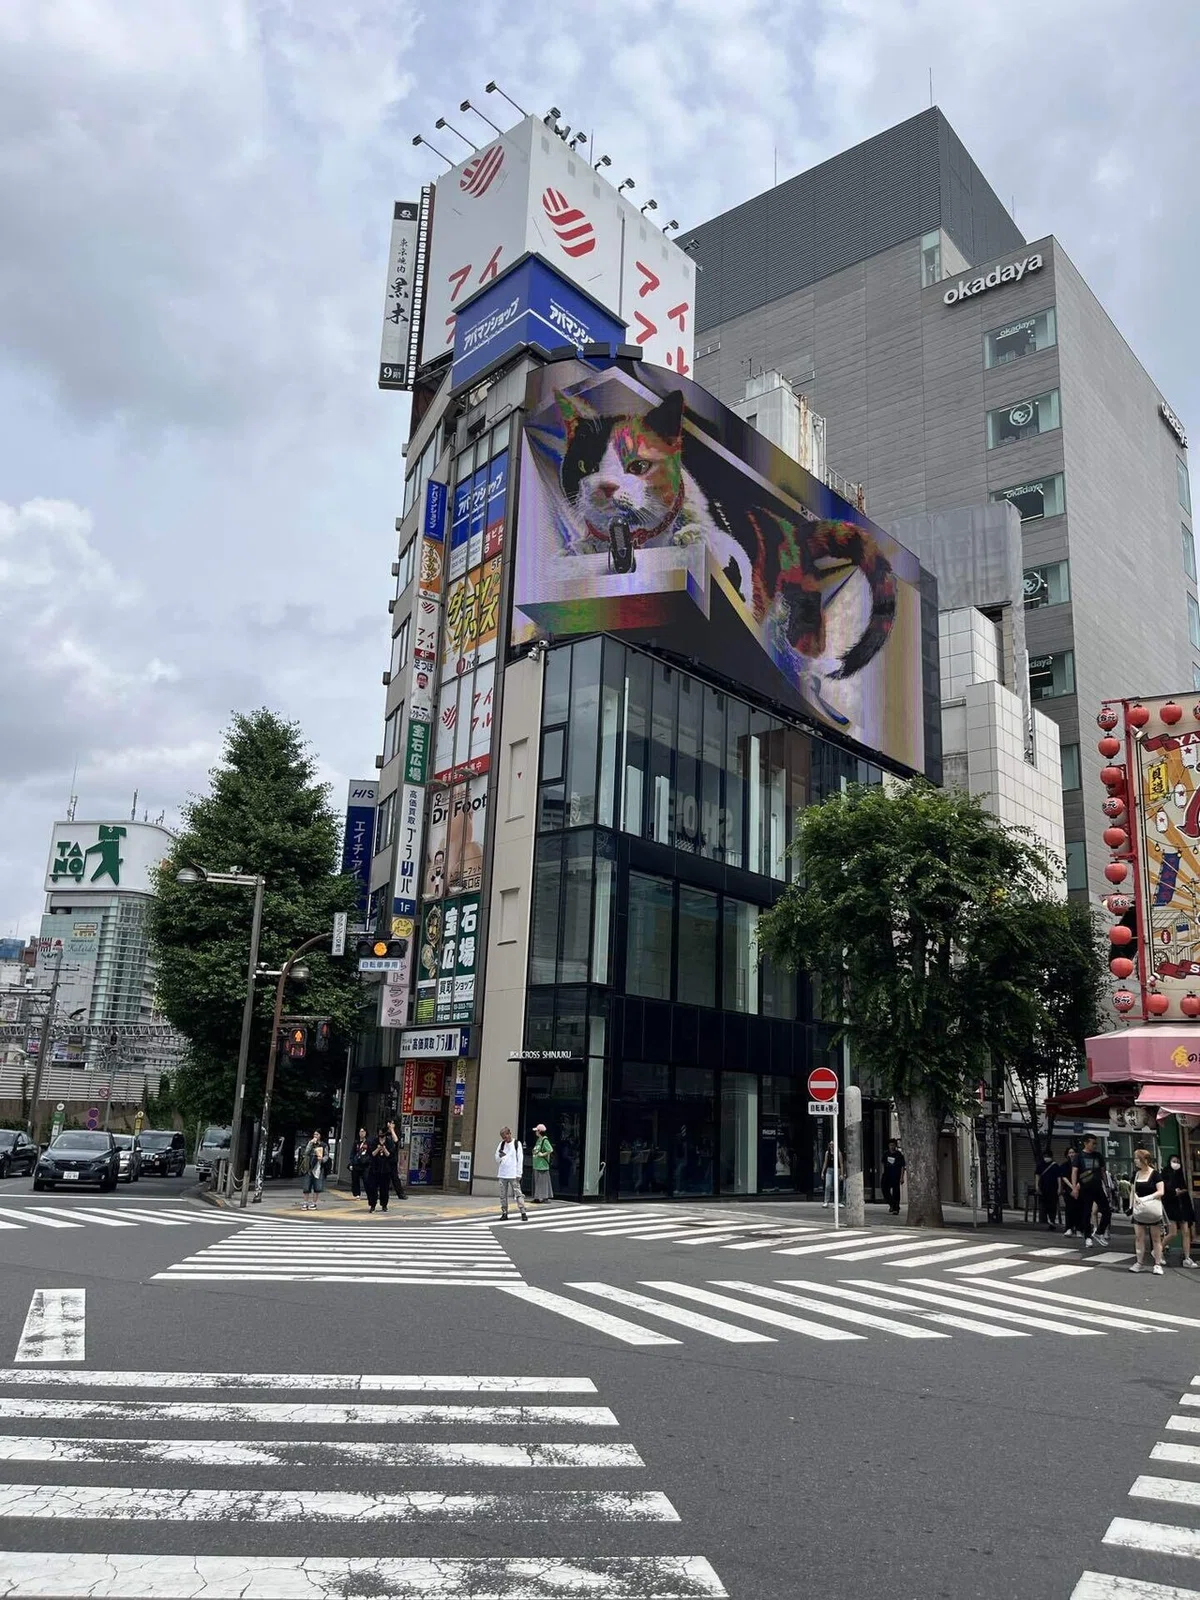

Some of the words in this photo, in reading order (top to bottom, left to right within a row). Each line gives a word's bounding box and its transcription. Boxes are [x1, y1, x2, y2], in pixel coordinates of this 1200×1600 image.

[943, 254, 1043, 305] okadaya
[463, 297, 520, 351] アパマンショップ
[550, 304, 596, 344] アパマンショ
[1000, 319, 1035, 337] okadaya
[491, 556, 502, 571] 5F
[420, 649, 430, 658] 4F
[1029, 658, 1053, 669] daya
[409, 724, 425, 782] 宝石広場
[352, 788, 375, 799] HIS
[407, 789, 417, 825] 高価買取
[433, 807, 448, 825] Dr
[454, 793, 487, 818] Foot
[57, 841, 83, 857] TA
[53, 858, 83, 873] NO
[400, 827, 416, 895] プラリバ
[400, 902, 411, 912] 1F
[444, 903, 478, 937] 宝石
[442, 936, 475, 969] 広場
[412, 1037, 435, 1050] 高価買取
[461, 1035, 469, 1047] 1F
[521, 1050, 540, 1059] CROSS
[542, 1050, 572, 1059] SHINJUKU
